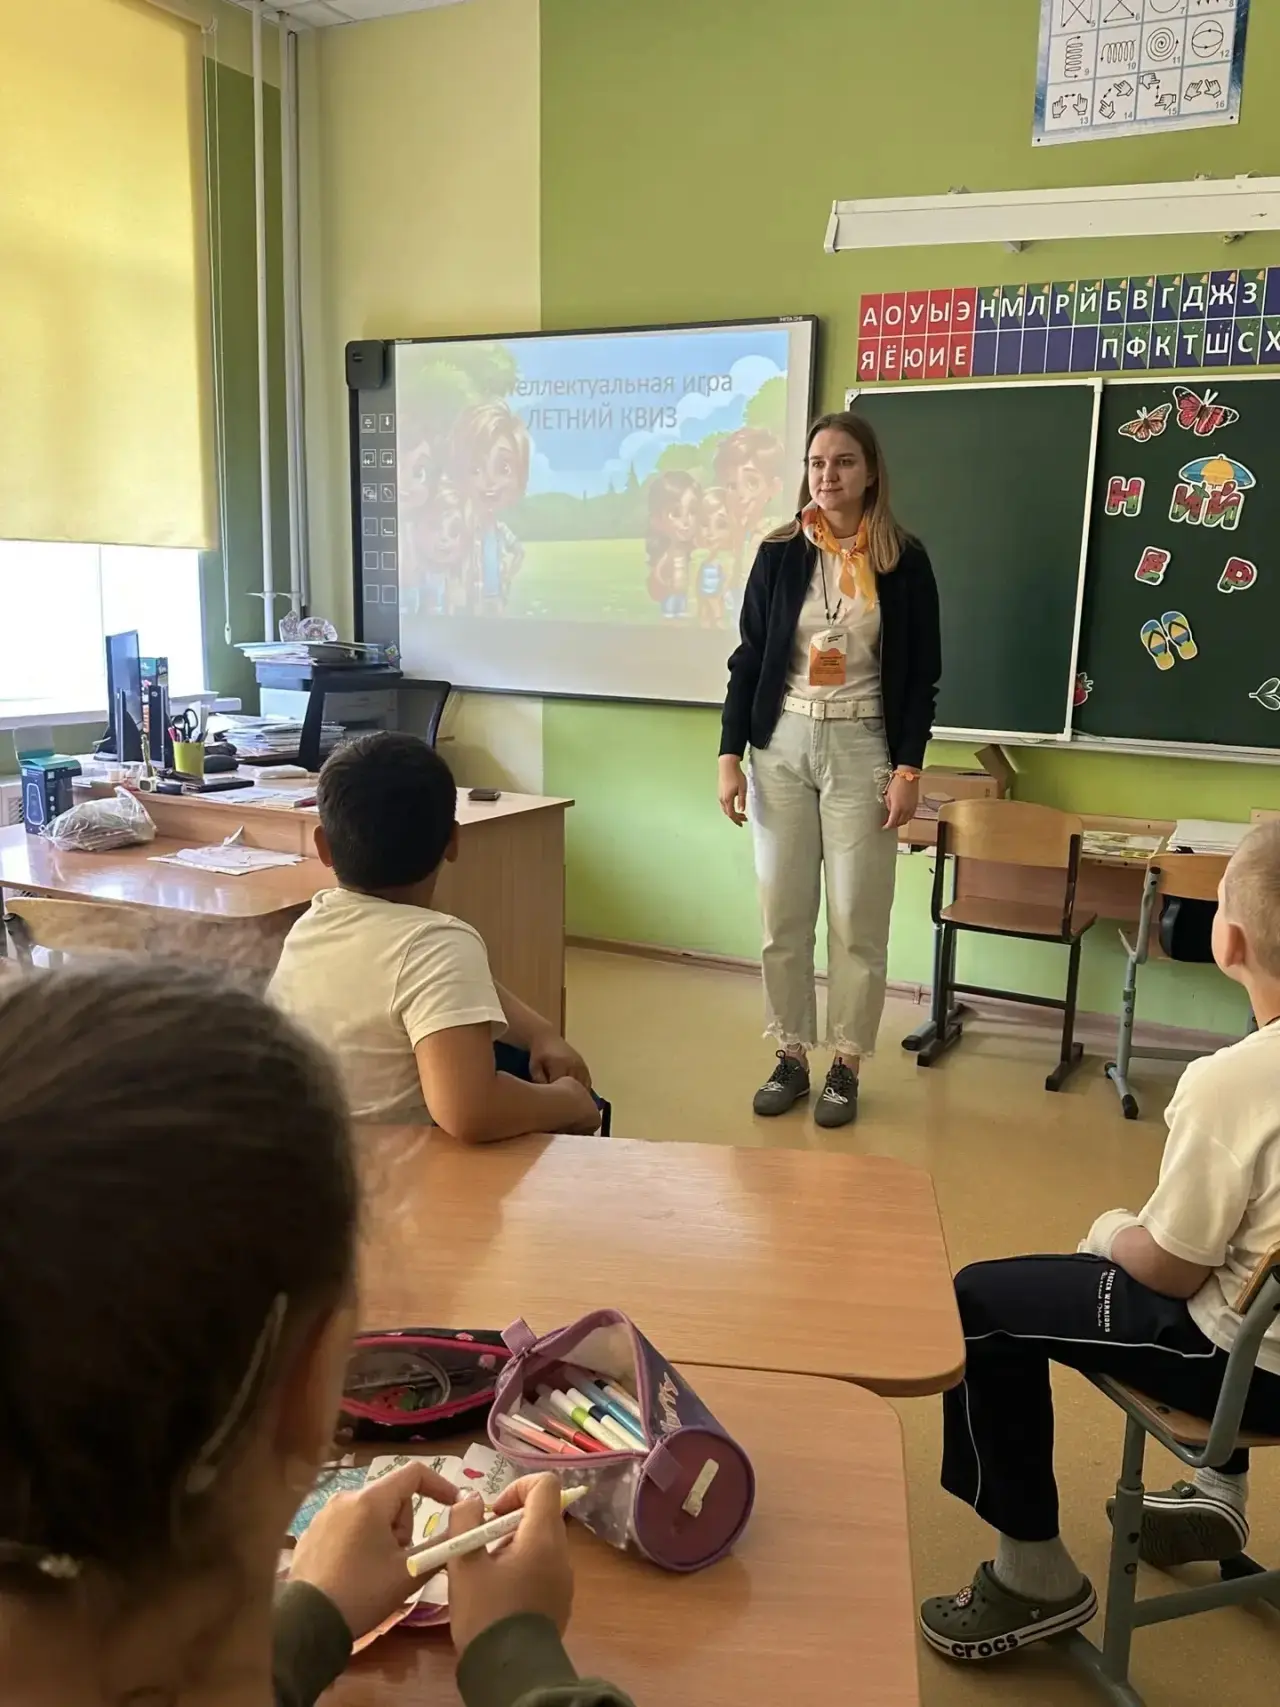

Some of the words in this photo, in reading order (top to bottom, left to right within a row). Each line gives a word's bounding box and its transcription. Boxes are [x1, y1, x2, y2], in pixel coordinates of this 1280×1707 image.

[1180, 7, 1185, 15] 7
[1084, 68, 1090, 76] 9
[1127, 62, 1136, 70] 10
[1172, 56, 1181, 64] 11
[1220, 49, 1230, 58] 12
[1080, 117, 1089, 125] 13
[1124, 111, 1133, 120] 14
[1168, 107, 1177, 116] 15
[1215, 100, 1225, 109] 16
[863, 307, 877, 326] А
[885, 306, 901, 325] О
[910, 304, 924, 324] У
[930, 303, 949, 322] Ы
[956, 301, 970, 320] Э
[980, 299, 995, 318] Н
[1001, 297, 1022, 317] М
[1028, 296, 1044, 315] Л
[1056, 295, 1069, 314] Р
[1080, 287, 1096, 312] Й
[1107, 291, 1121, 311] Б
[1133, 290, 1148, 309] В
[1162, 288, 1174, 308] Г
[1183, 286, 1203, 312] Д
[1209, 284, 1234, 305] Ж
[1243, 282, 1256, 304] З
[861, 351, 874, 370] Я
[885, 345, 896, 368] Ё
[904, 348, 923, 367] Ю
[930, 347, 944, 366] И
[955, 346, 966, 365] Е
[1102, 338, 1118, 358] П
[1126, 336, 1146, 357] Ф
[1156, 336, 1171, 356] К
[1183, 334, 1198, 354] Т
[1206, 333, 1229, 354] Ш
[1238, 332, 1254, 352] С
[1265, 330, 1280, 351] Х
[682, 374, 732, 397] игра
[526, 401, 612, 430] ЛЕТНИЙ
[621, 406, 677, 429] КВИЗ
